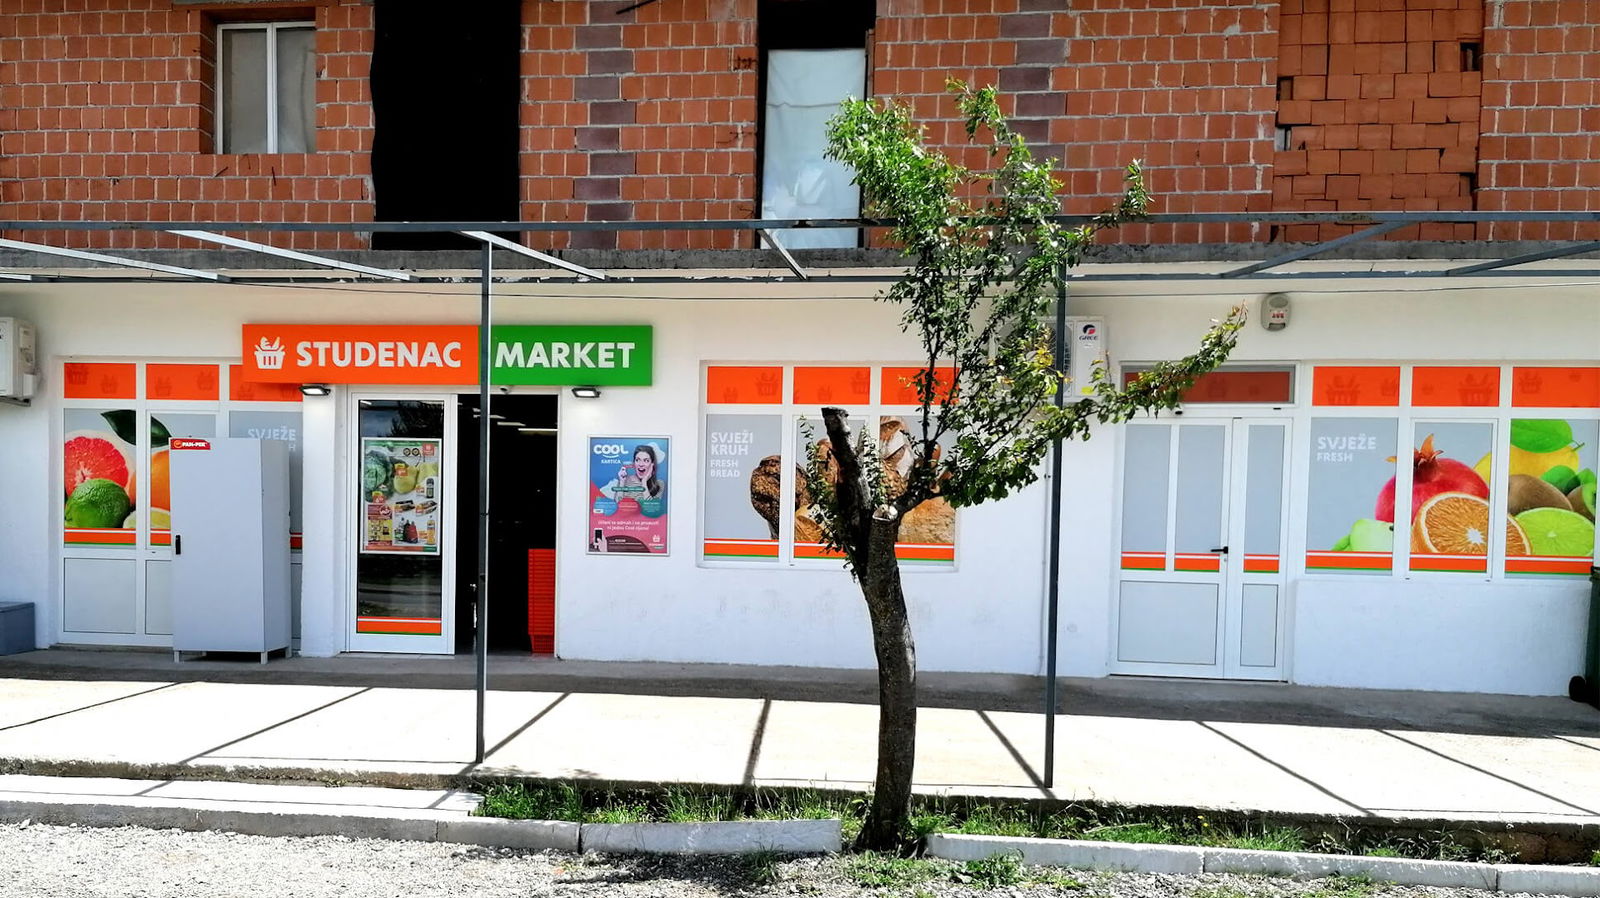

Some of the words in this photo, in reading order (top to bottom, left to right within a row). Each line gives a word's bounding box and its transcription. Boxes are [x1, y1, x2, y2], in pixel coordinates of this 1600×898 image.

[296, 341, 461, 368] STUDENAC
[494, 342, 636, 369] MARKET
[247, 426, 297, 441] SVJEŽE
[711, 429, 754, 444] SVJEŽI
[1317, 432, 1377, 450] SVJEŽE
[593, 444, 629, 455] COOL
[711, 444, 749, 456] KRUH
[1316, 451, 1353, 462] FRESH
[710, 459, 738, 468] FRESH
[710, 469, 741, 478] BREAD
